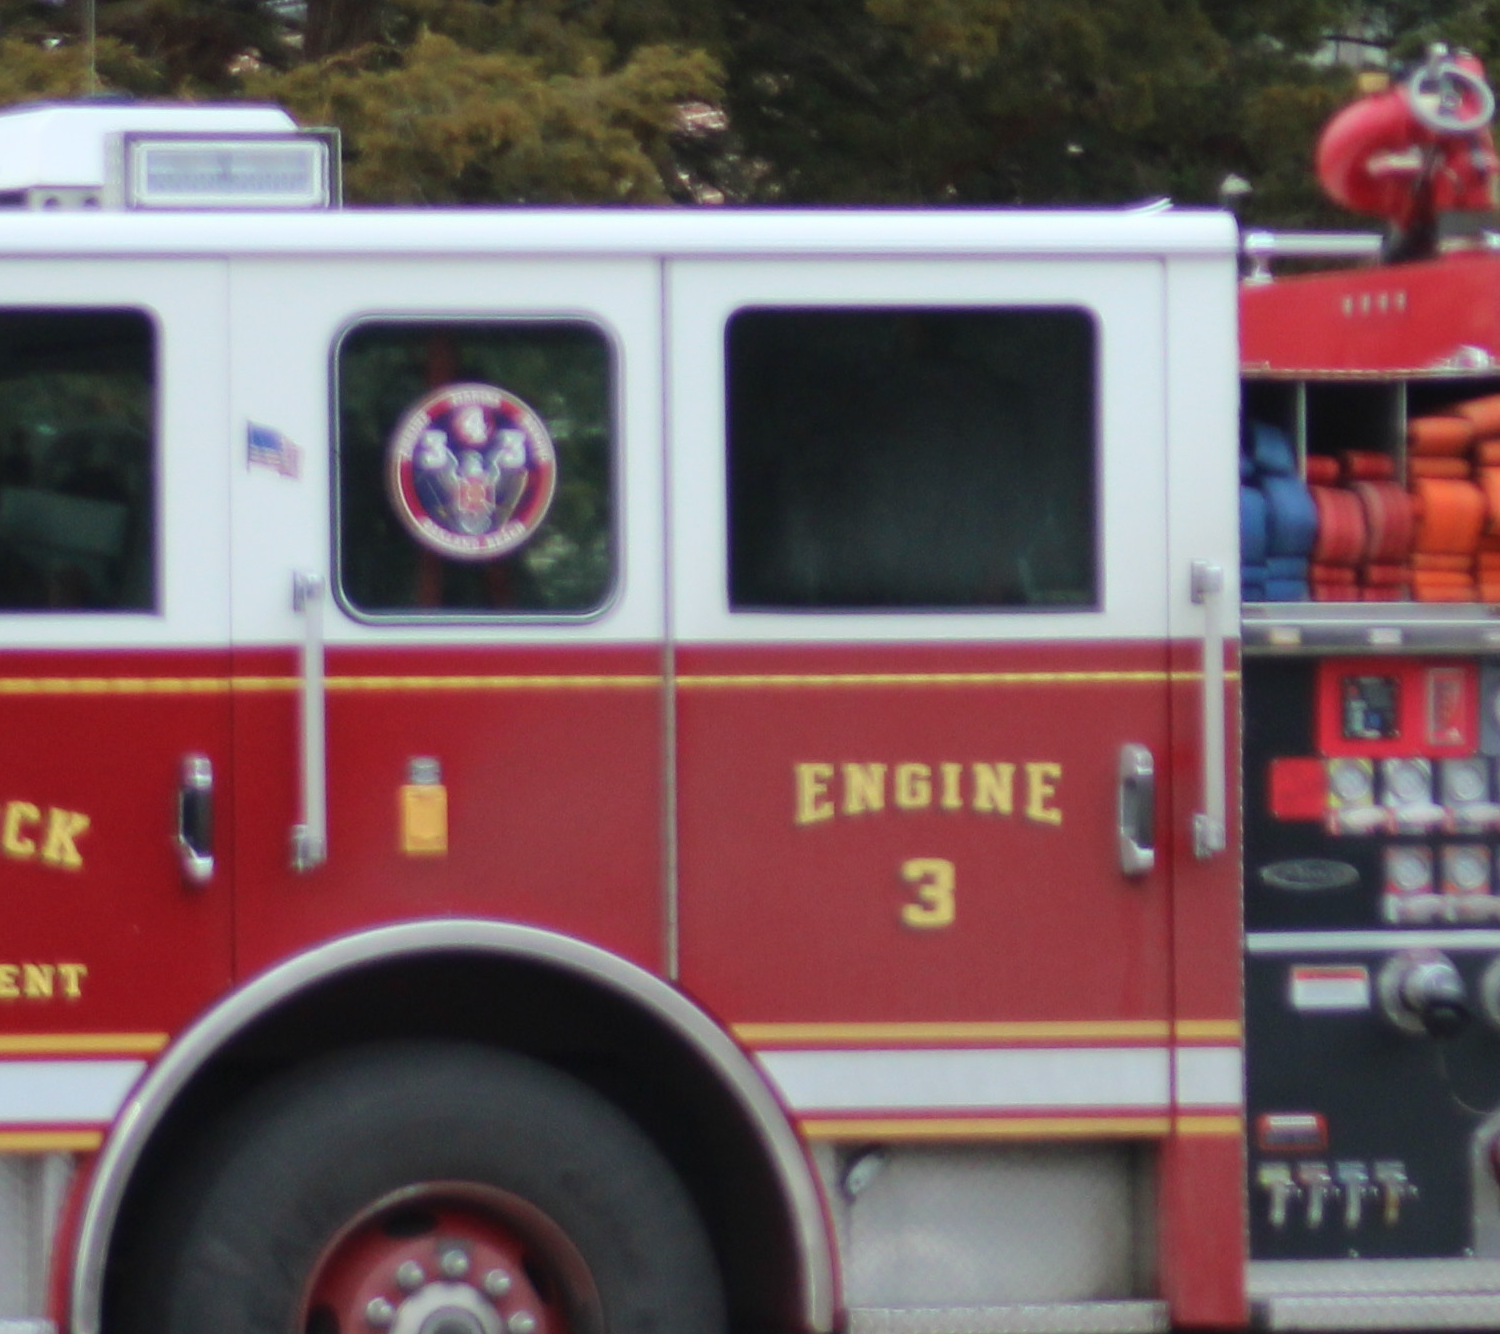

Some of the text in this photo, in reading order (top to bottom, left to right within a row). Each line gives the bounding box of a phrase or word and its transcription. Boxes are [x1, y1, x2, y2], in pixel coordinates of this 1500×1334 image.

[461, 406, 488, 443] 4
[419, 430, 448, 467] 3
[500, 429, 527, 466] 3
[793, 761, 1063, 827] ENGINE
[900, 857, 956, 930] 3
